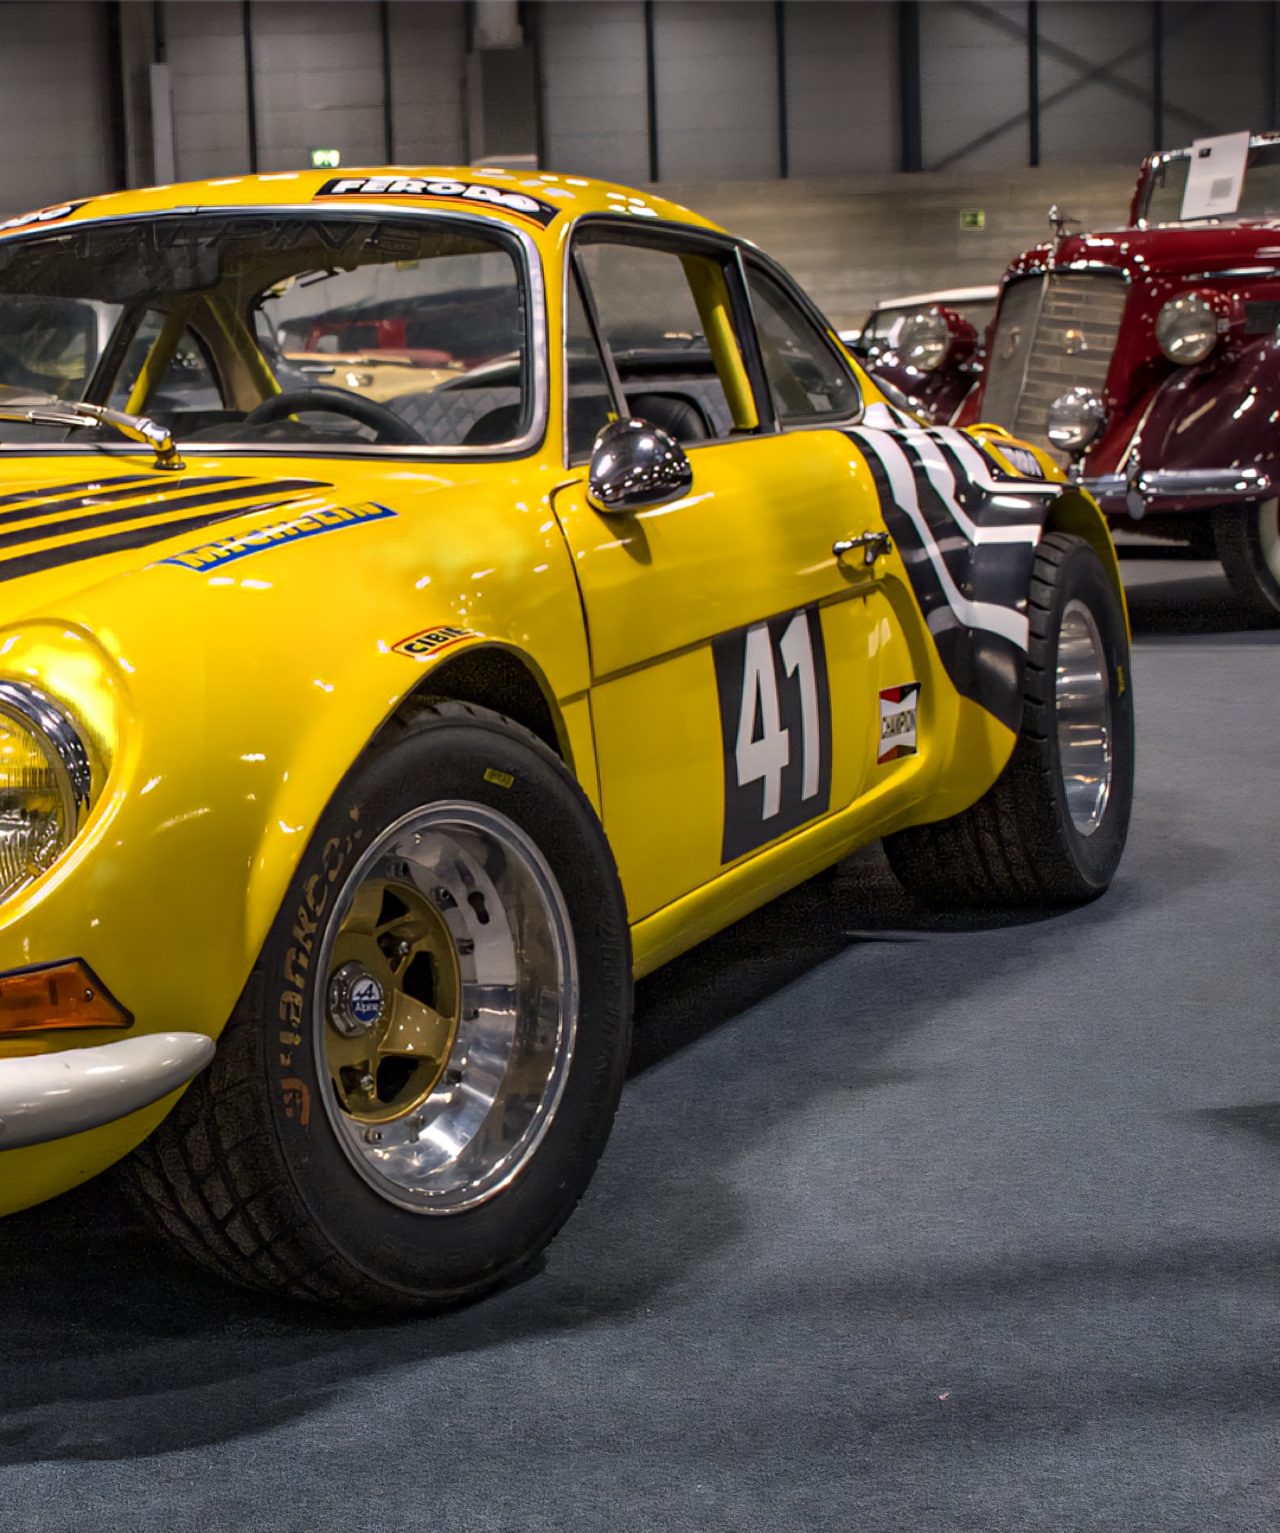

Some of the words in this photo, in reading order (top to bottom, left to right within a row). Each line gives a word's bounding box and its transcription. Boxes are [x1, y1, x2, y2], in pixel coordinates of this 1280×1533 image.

[331, 177, 540, 213] FERODO
[175, 501, 384, 569] MICHELIN
[735, 608, 820, 821] 41
